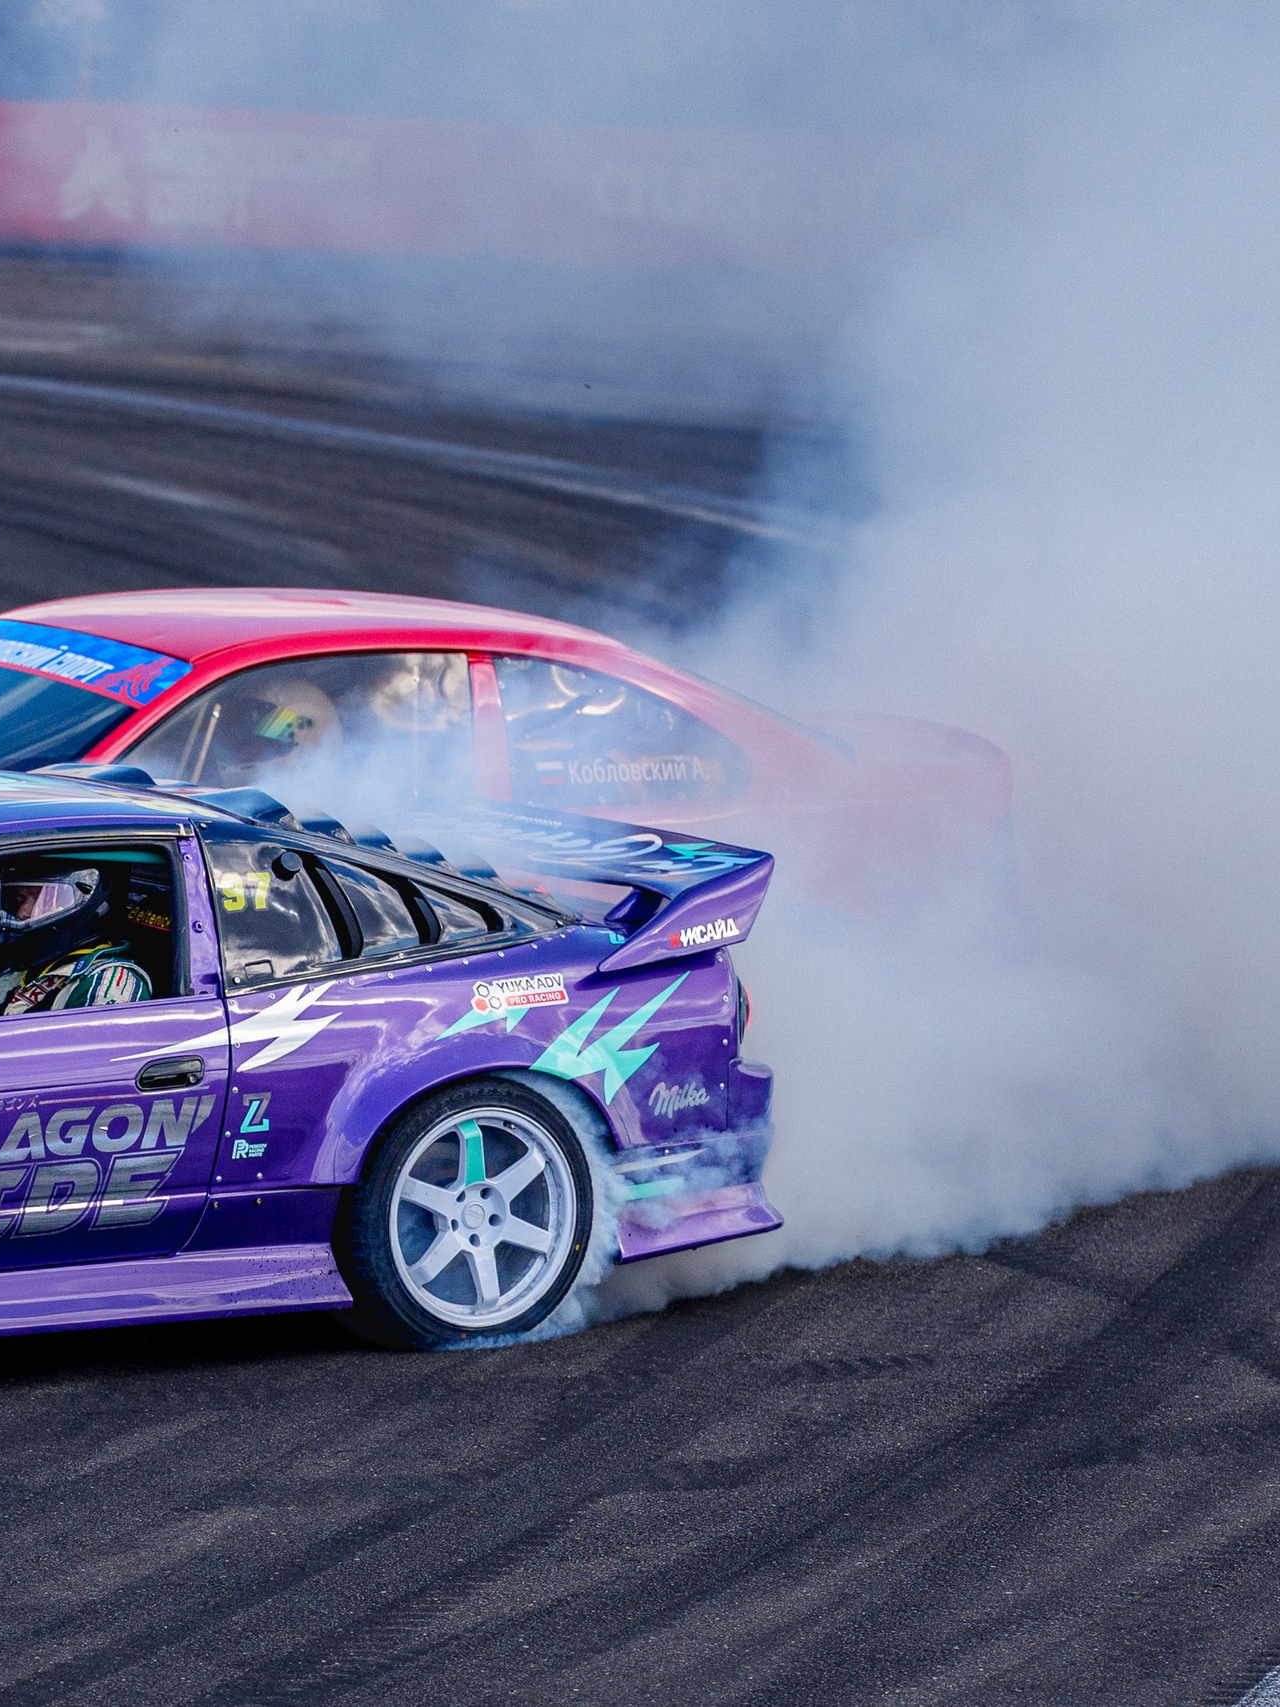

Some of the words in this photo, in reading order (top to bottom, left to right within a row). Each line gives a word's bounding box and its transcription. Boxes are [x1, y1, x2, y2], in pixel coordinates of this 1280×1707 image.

[570, 755, 687, 785] Кобловский
[496, 979, 535, 994] YUKA
[537, 975, 562, 990] ADV
[509, 995, 528, 1006] PRO
[529, 992, 562, 1003] RACING
[648, 1081, 710, 1119] Milka
